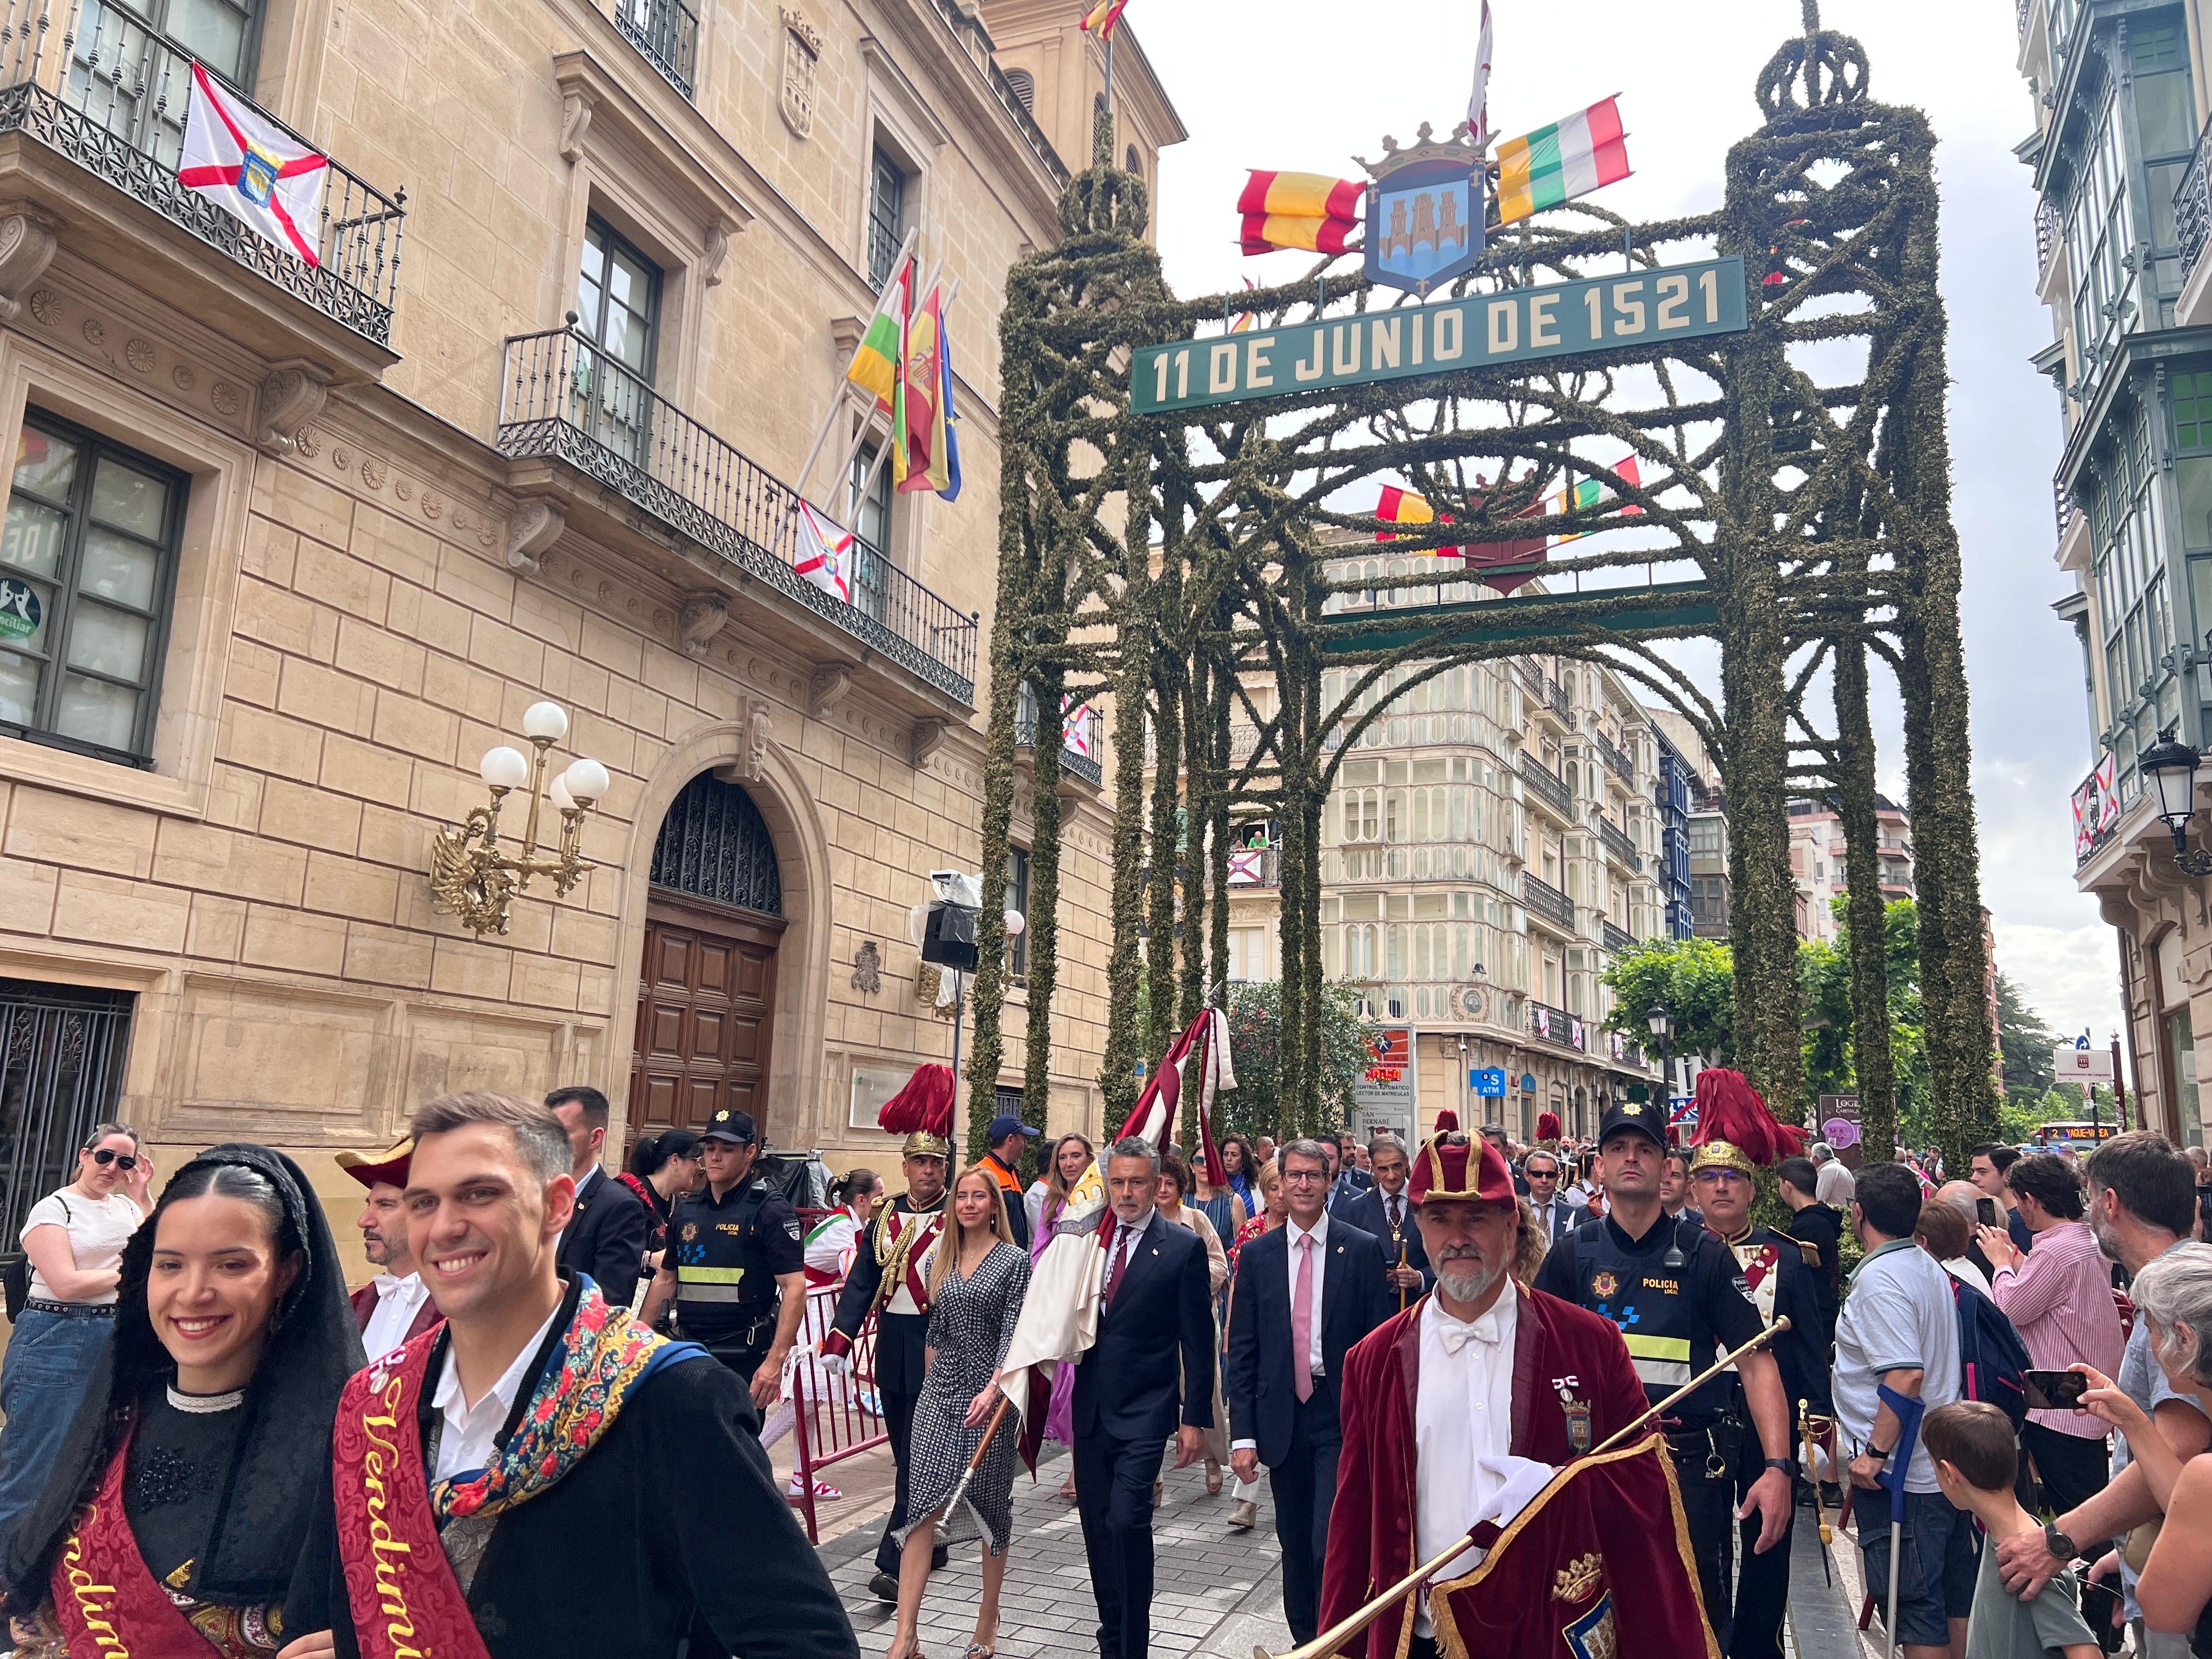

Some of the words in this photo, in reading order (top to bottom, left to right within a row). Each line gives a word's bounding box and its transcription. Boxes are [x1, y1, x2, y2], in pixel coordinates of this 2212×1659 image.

[1154, 348, 1188, 403] 11
[1209, 336, 1275, 394] DE
[1295, 307, 1464, 382] JUNIO
[1488, 291, 1561, 356] DE
[1584, 268, 1719, 339] 1521
[1491, 1074, 1499, 1086] S
[1482, 1086, 1499, 1094] ATM
[2052, 1128, 2058, 1138] 2
[1643, 1278, 1679, 1290] POLICIA
